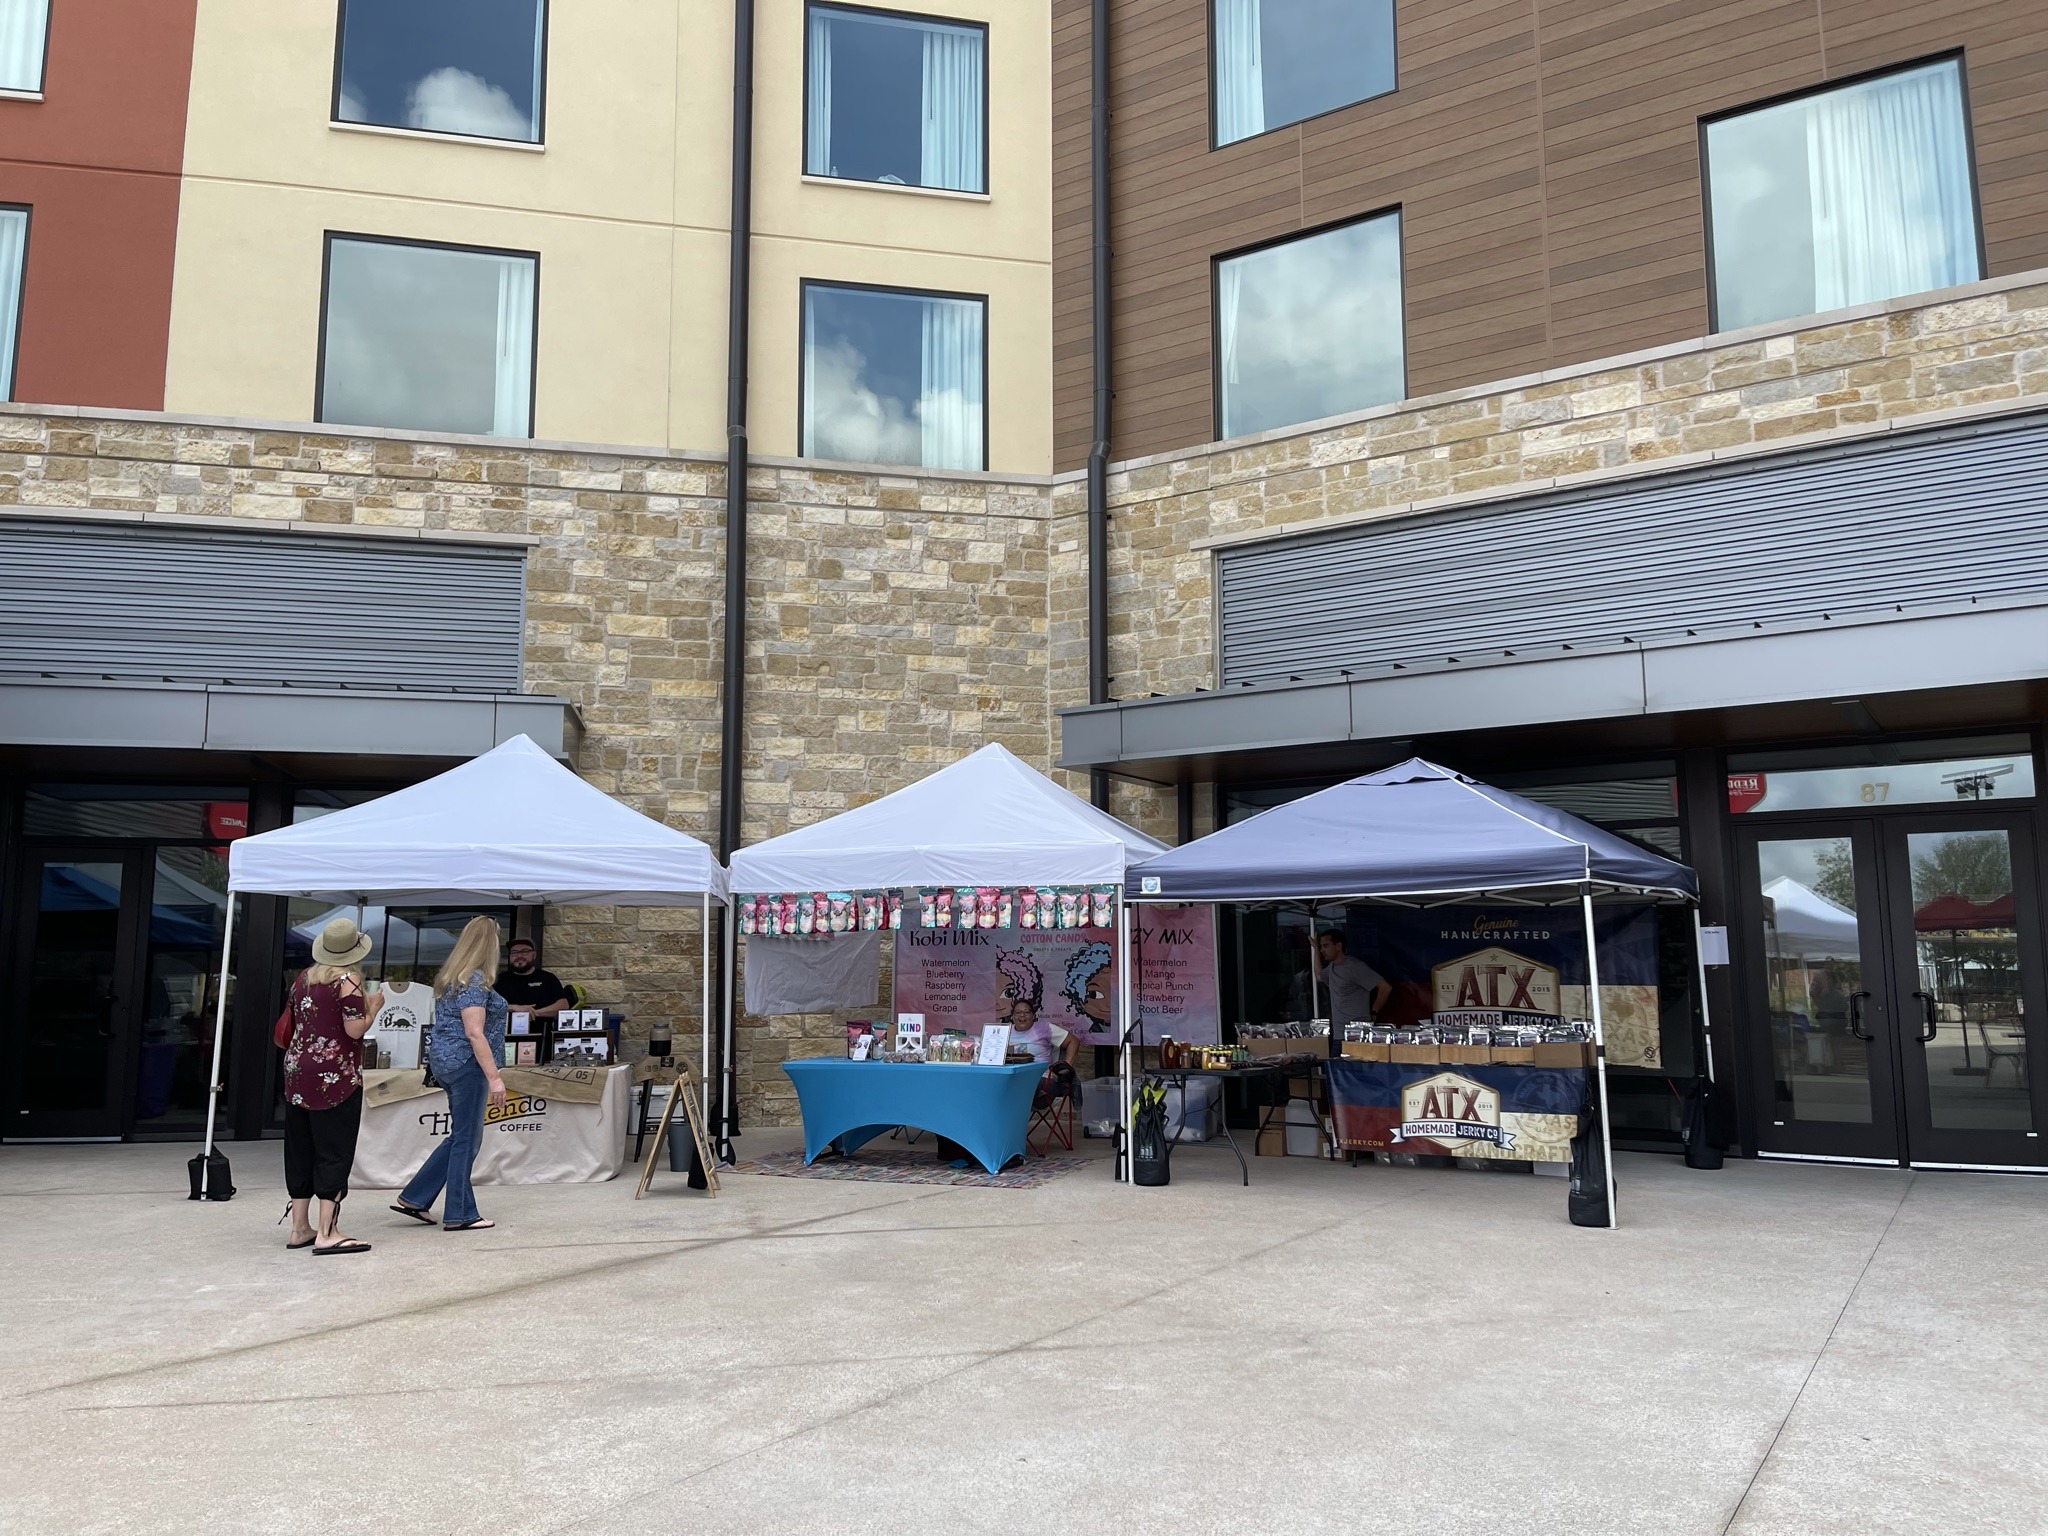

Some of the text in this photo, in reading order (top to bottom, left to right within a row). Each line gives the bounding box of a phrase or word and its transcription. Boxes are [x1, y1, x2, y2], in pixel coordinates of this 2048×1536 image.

[1859, 782, 1890, 802] 87
[1474, 915, 1519, 934] Genuine
[910, 930, 989, 946] Kobi Mix
[1020, 932, 1087, 943] COTTON CANDY
[1159, 928, 1194, 945] MIX
[1441, 930, 1550, 939] HANDCRAFTED
[921, 959, 970, 967] Watermelon
[926, 970, 965, 980] Blueberry
[1145, 970, 1175, 980] Mango
[925, 981, 966, 991] Raspberry
[1165, 981, 1194, 991] Punch
[1455, 964, 1539, 1010] ATX
[924, 992, 966, 1001] Lemonade
[1136, 993, 1185, 1004] Strawberry
[932, 1004, 958, 1014] Grape
[1138, 1005, 1184, 1014] Root Beer
[401, 1006, 417, 1025] COFFEE
[1437, 1013, 1500, 1026] HOMEMADE
[1503, 1014, 1542, 1026] JERKY
[900, 1023, 921, 1033] KIND
[575, 1070, 588, 1080] 05
[1421, 1085, 1482, 1122] ATX
[419, 1095, 547, 1136] Hendo
[500, 1123, 542, 1132] COFFEE
[1405, 1123, 1455, 1135] HOMEMADE
[1457, 1125, 1486, 1137] JERKY
[1337, 1138, 1384, 1147] XJERKY.COM
